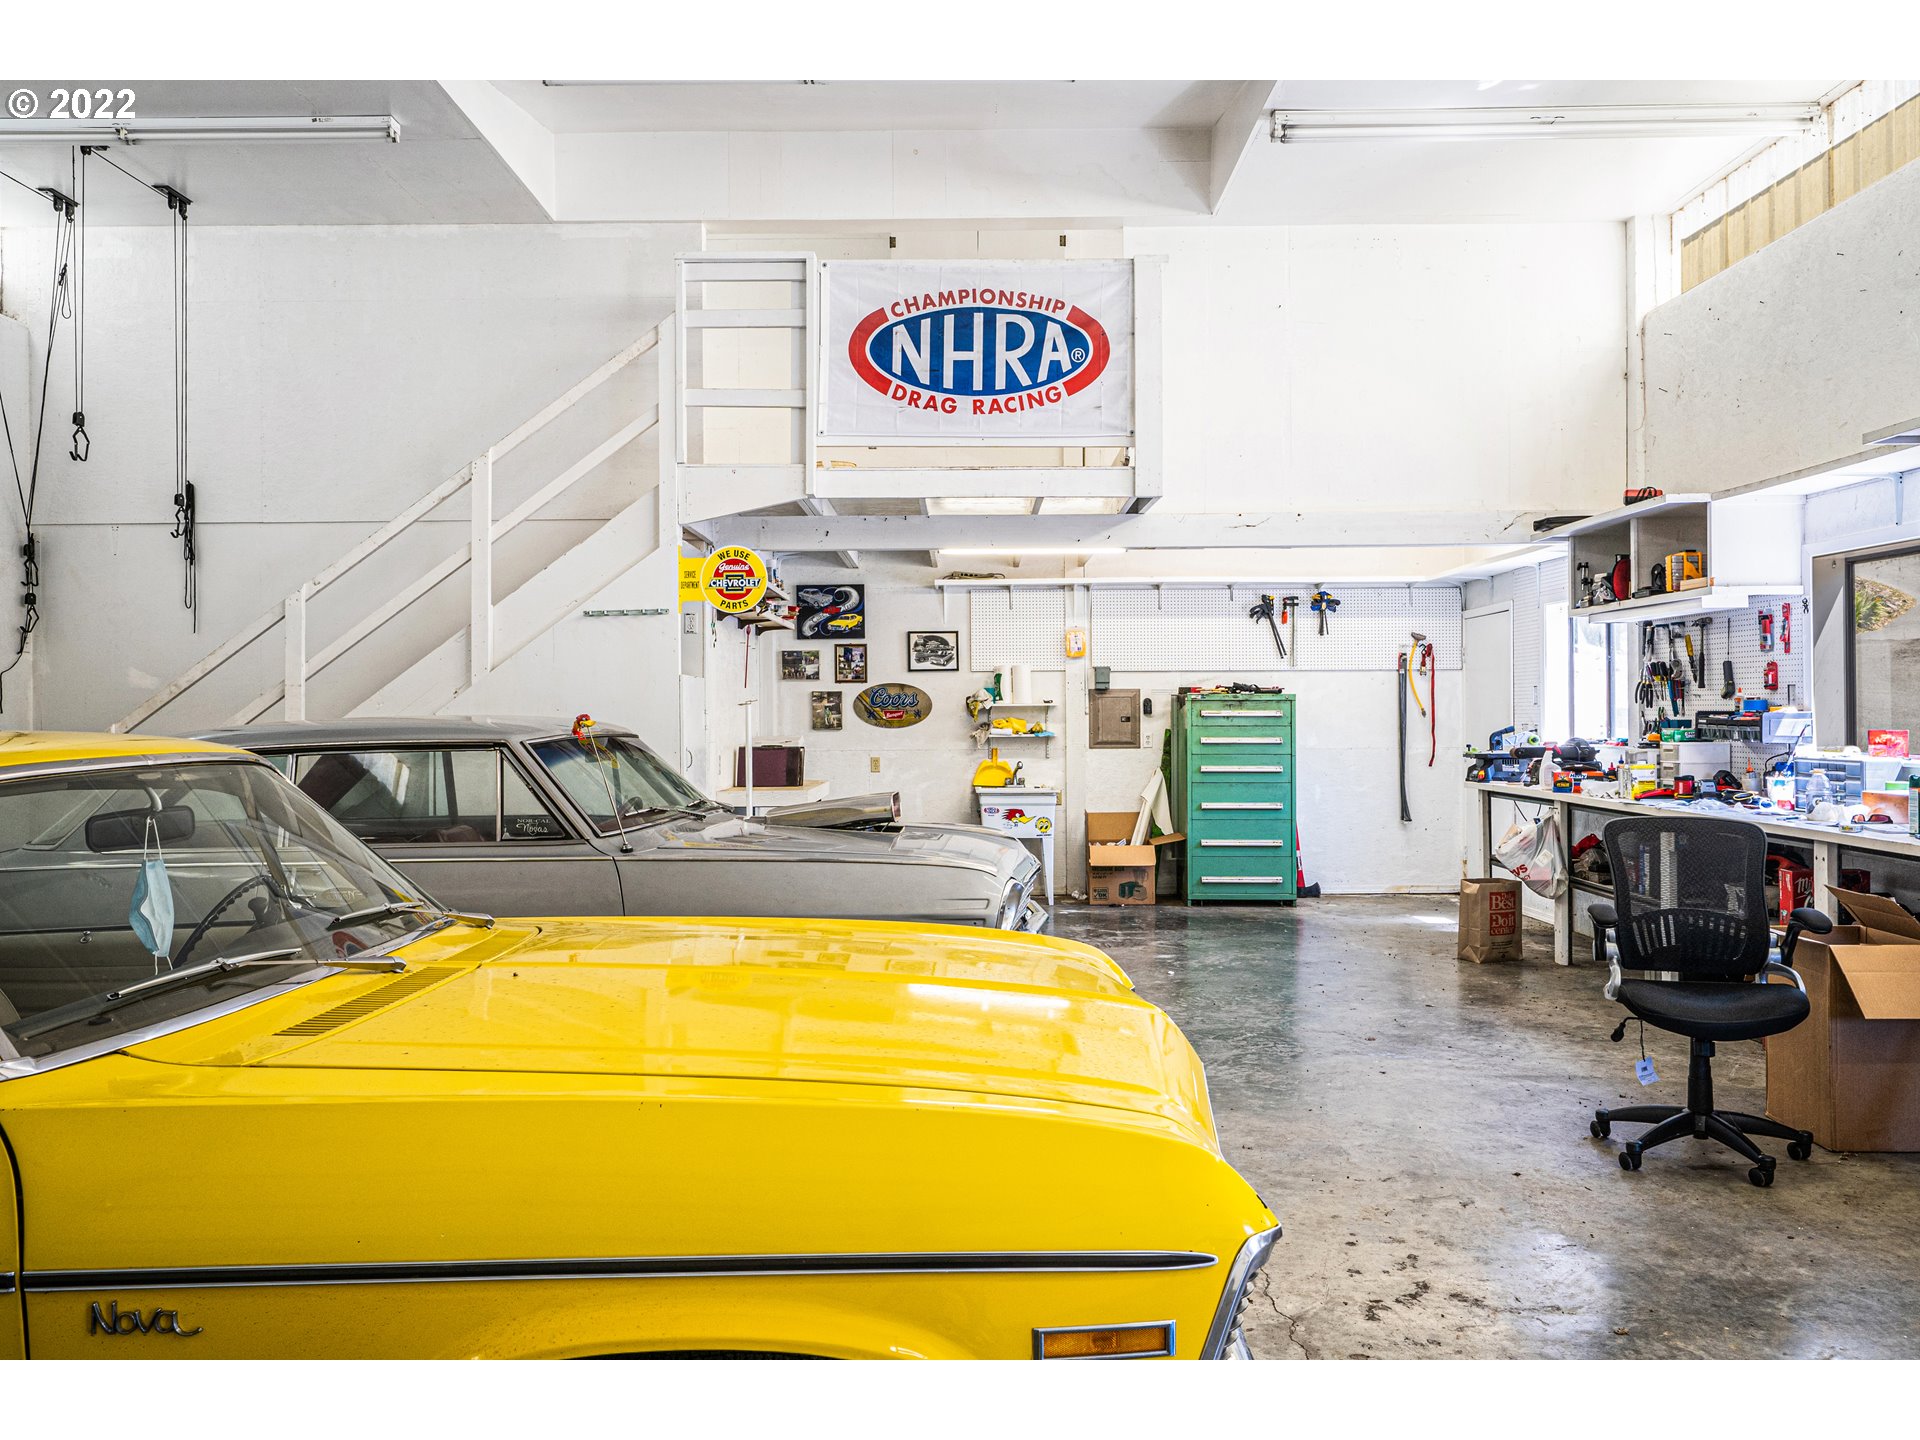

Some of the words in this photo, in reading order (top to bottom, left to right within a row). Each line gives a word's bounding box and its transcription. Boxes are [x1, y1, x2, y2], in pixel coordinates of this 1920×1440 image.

[890, 288, 1066, 318] CHAMPIONSHIP
[892, 312, 1073, 391] NHRA
[891, 383, 957, 415] DRAG
[972, 385, 1062, 415] RACING
[717, 550, 731, 561] WE
[733, 549, 751, 561] USE
[718, 562, 750, 573] Genuine
[710, 578, 759, 587] CHEVROLET
[720, 599, 749, 610] PARTS
[870, 687, 919, 708] Coors
[515, 823, 549, 833] Novas
[1491, 895, 1514, 910] Best
[89, 1299, 204, 1337] Nova
